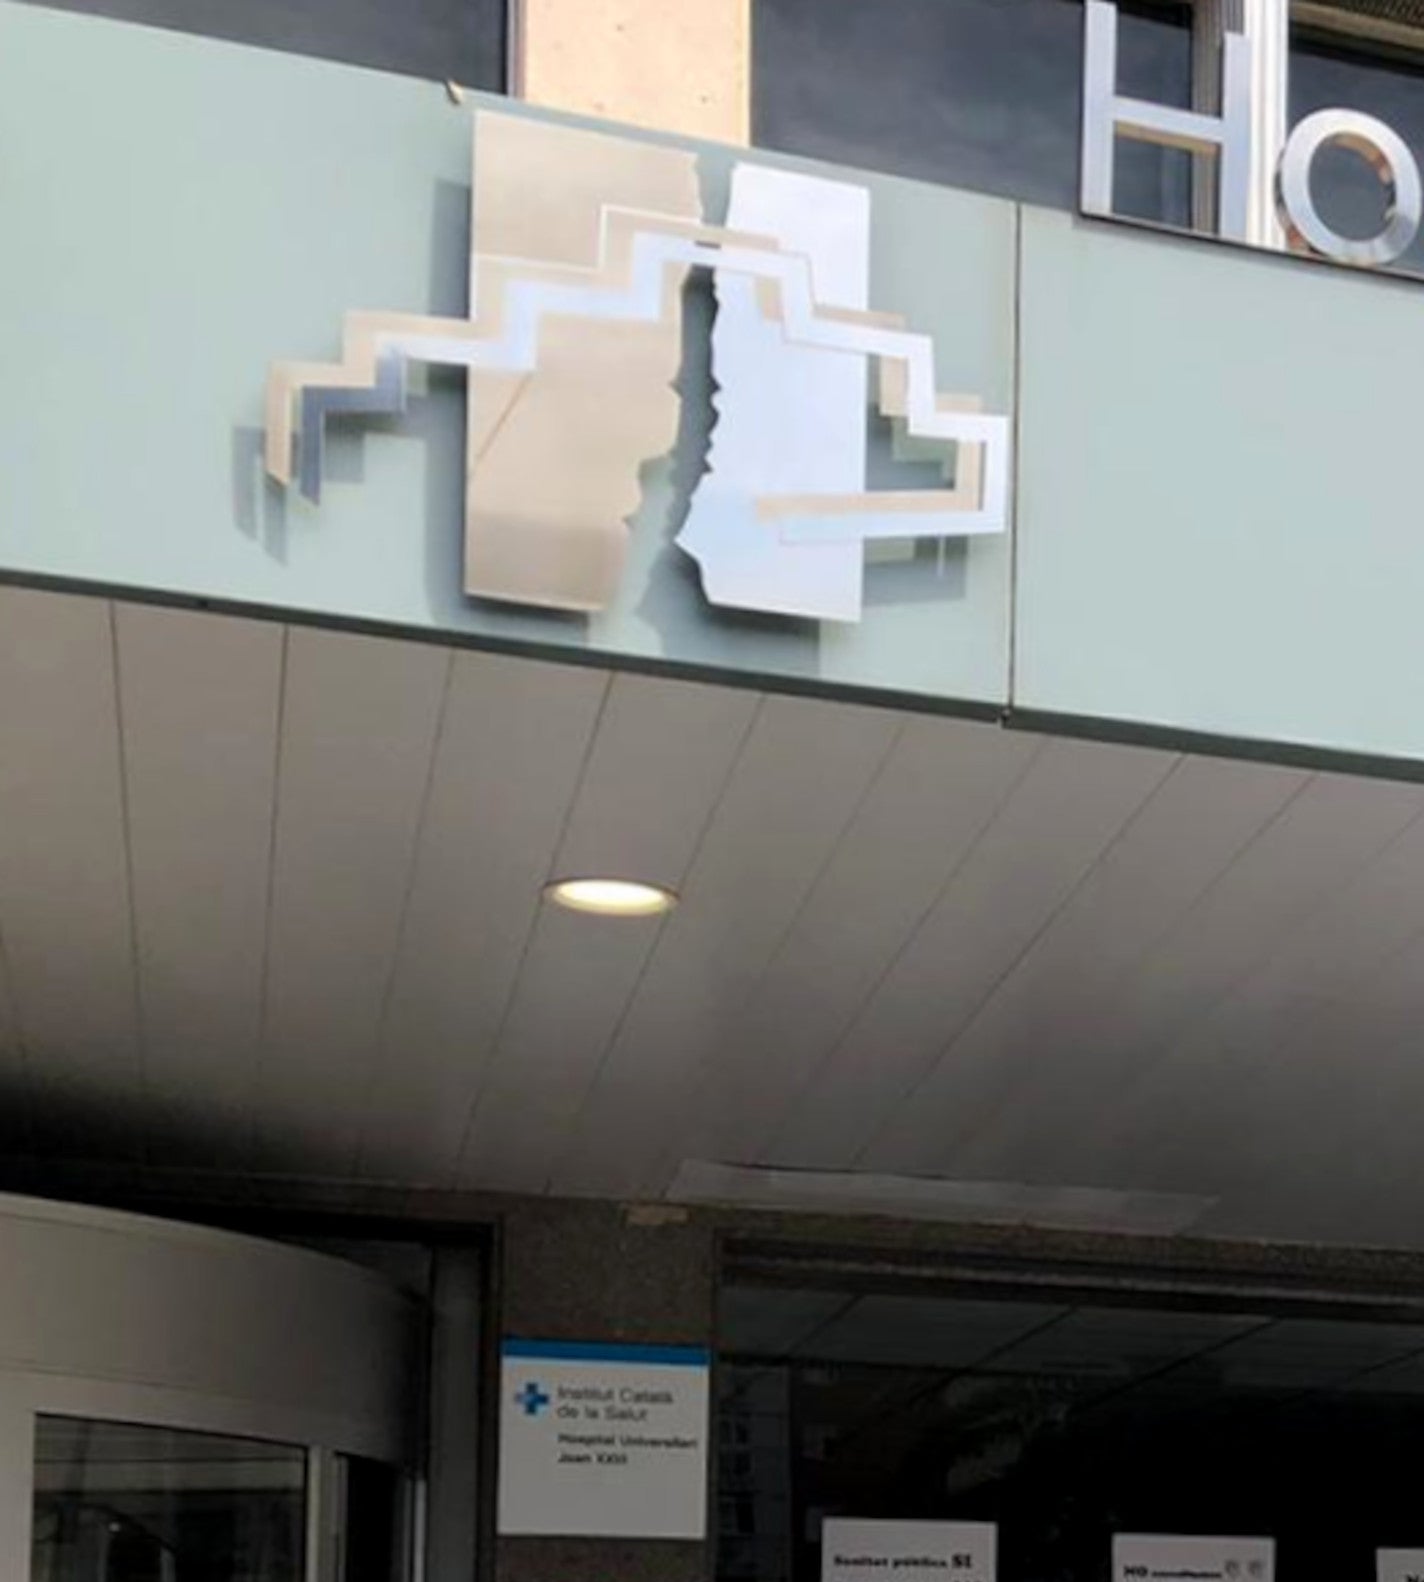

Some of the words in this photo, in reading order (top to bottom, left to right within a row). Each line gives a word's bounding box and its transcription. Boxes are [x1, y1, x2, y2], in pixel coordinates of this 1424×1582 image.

[557, 1385, 614, 1400] Institut
[557, 1404, 579, 1419] de
[584, 1406, 600, 1419] la
[604, 1405, 648, 1421] Salut
[557, 1433, 616, 1447] Hospital
[620, 1435, 697, 1449] Universitari
[557, 1452, 592, 1464] Joan
[1123, 1565, 1149, 1579] NO
